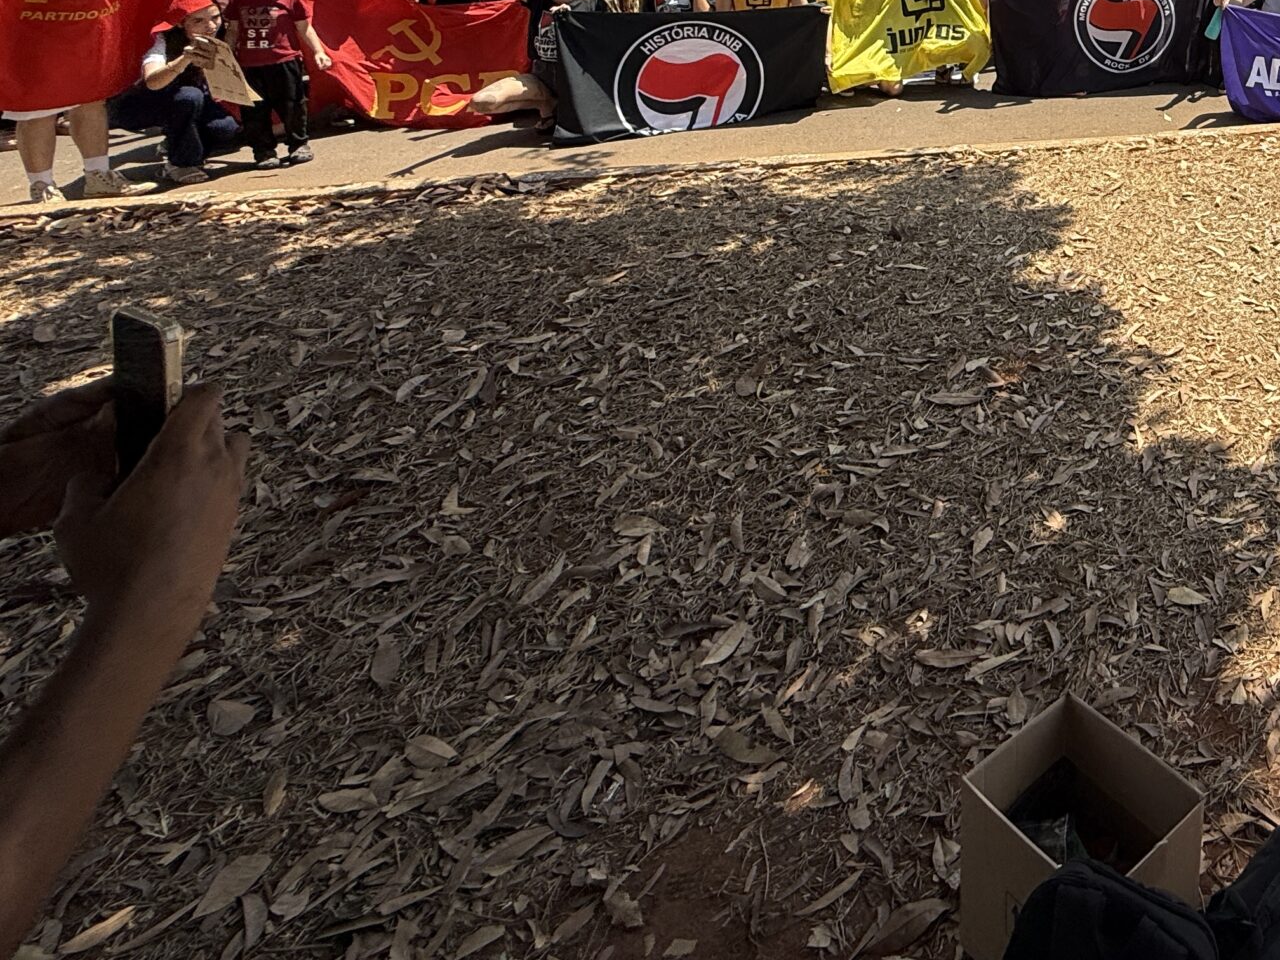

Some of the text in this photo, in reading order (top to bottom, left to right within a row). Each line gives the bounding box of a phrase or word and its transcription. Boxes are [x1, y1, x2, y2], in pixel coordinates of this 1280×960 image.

[19, 10, 98, 21] PARTIDO
[640, 26, 743, 55] HISTÓRIA UNB
